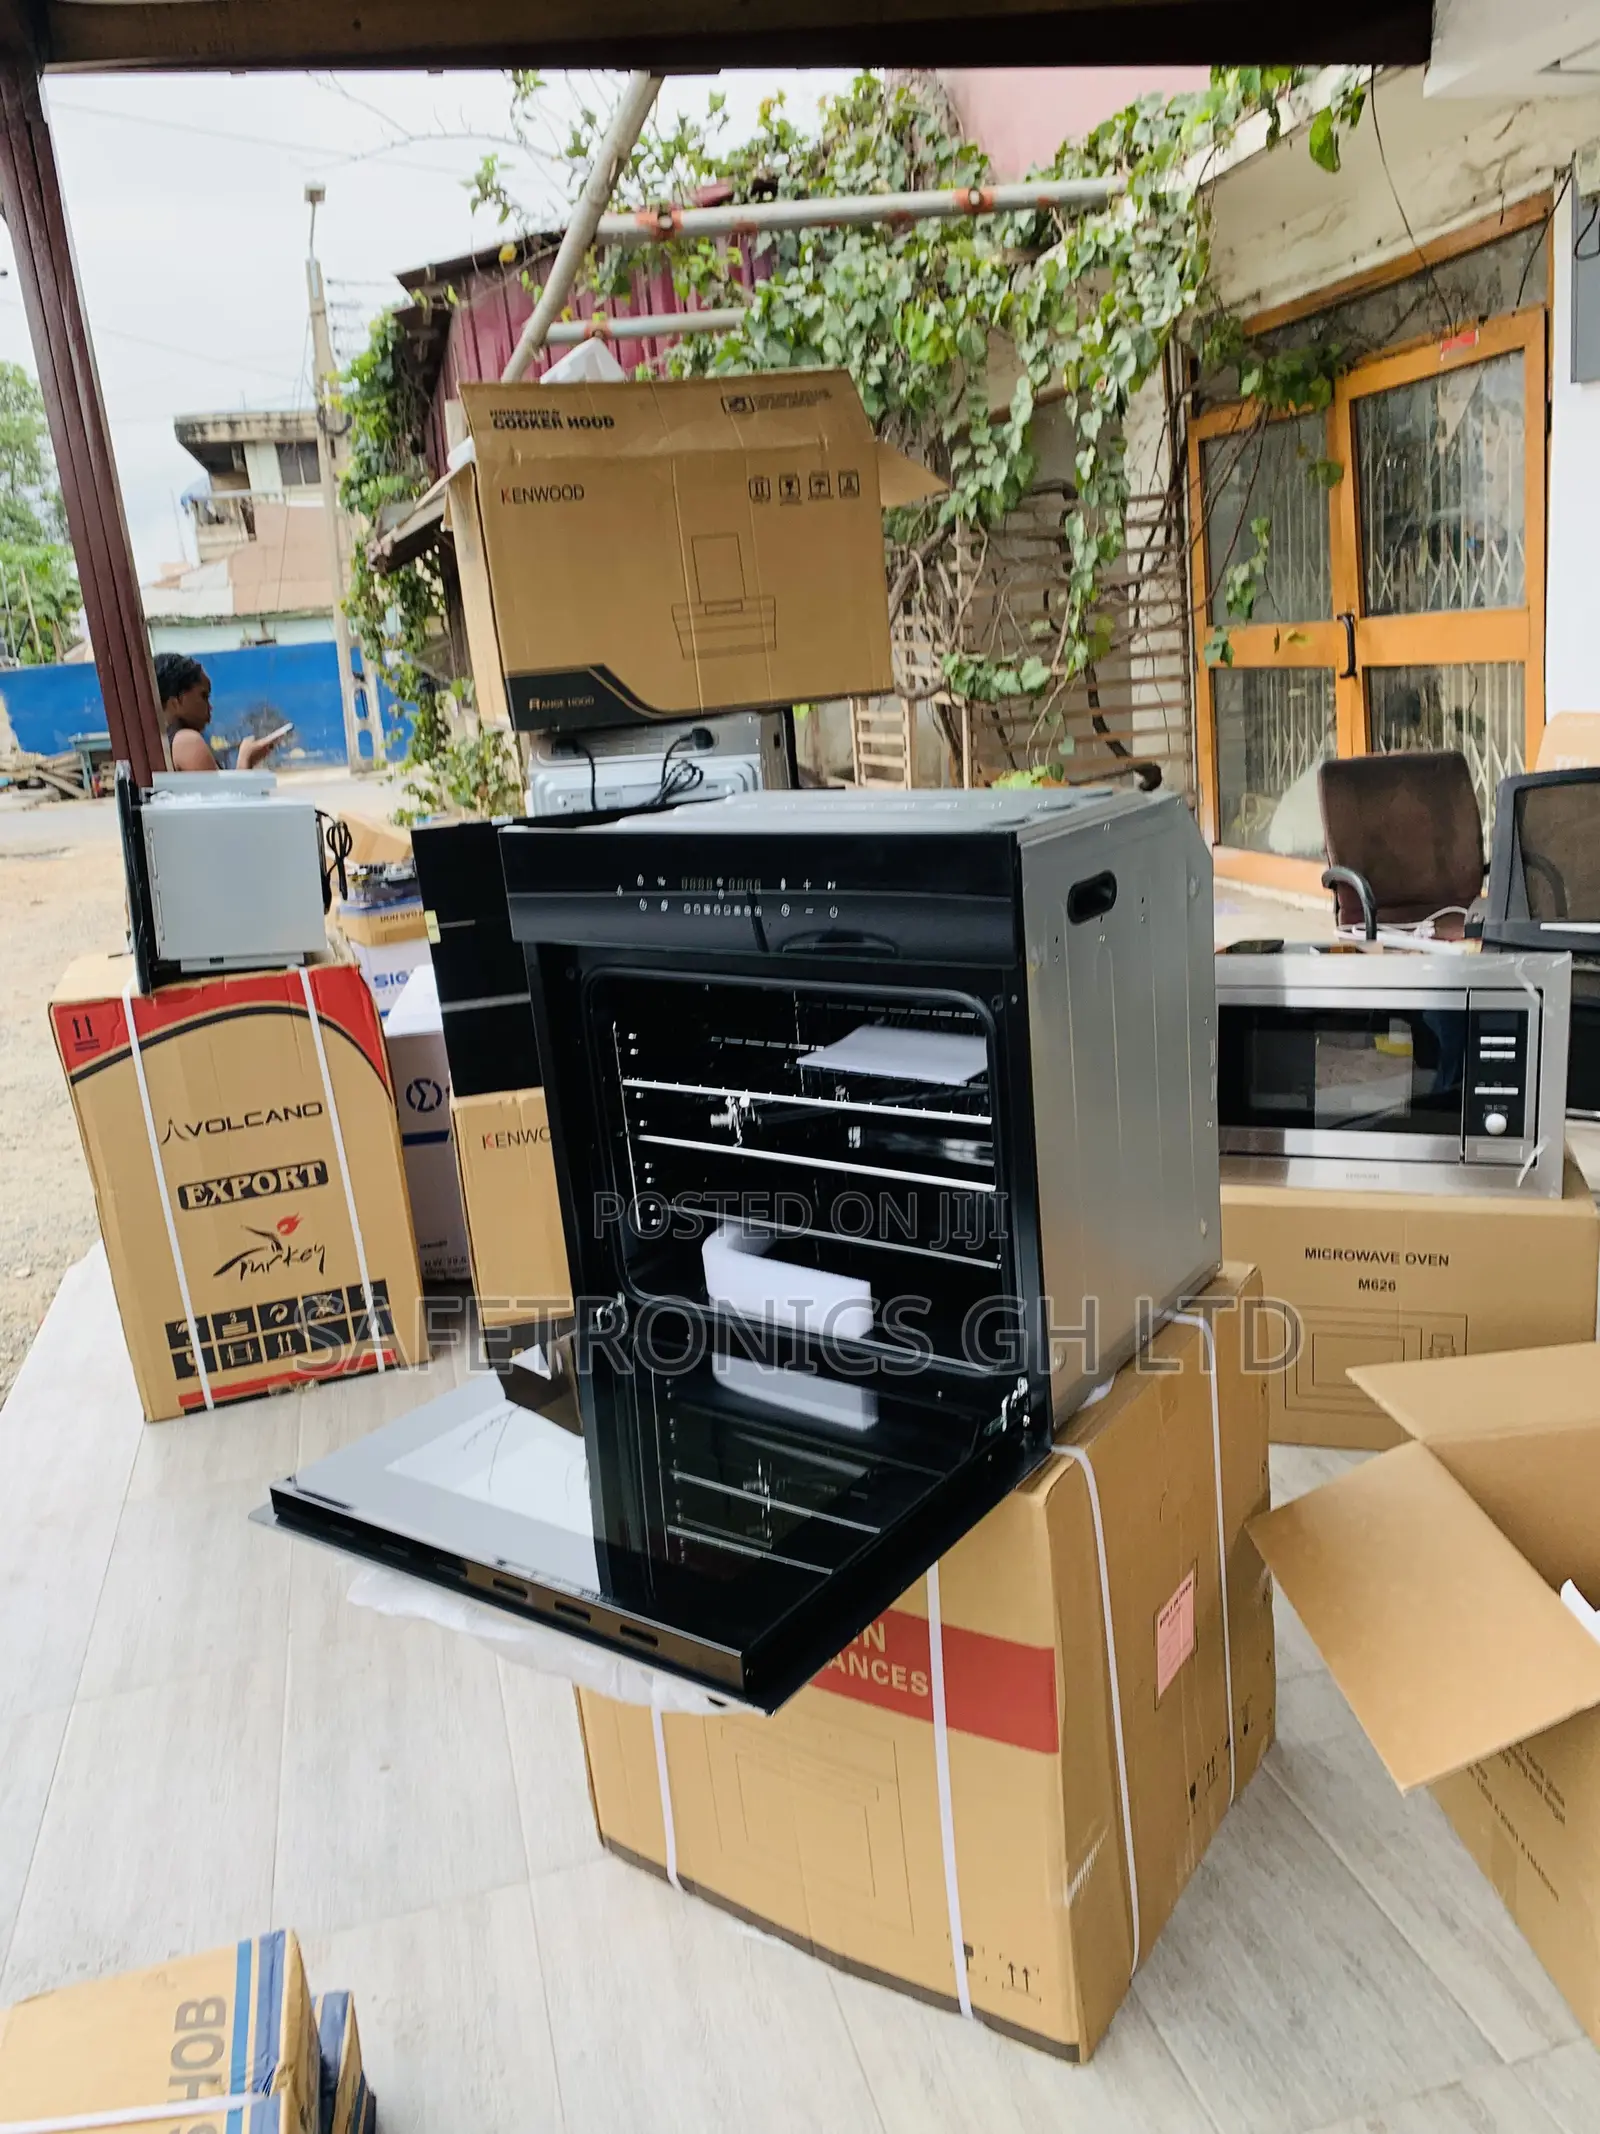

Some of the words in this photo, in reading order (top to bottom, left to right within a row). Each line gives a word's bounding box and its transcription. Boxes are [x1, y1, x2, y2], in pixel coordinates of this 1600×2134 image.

[493, 415, 564, 430] COOKER
[566, 414, 615, 430] HOOD
[501, 483, 585, 506] KENWOOD
[184, 1101, 323, 1138] VOLCANO
[183, 1162, 323, 1209] EXPORT
[1304, 1247, 1401, 1266] MICROWAVE
[1405, 1252, 1449, 1267] OVEN
[166, 1996, 227, 2104] HOB
